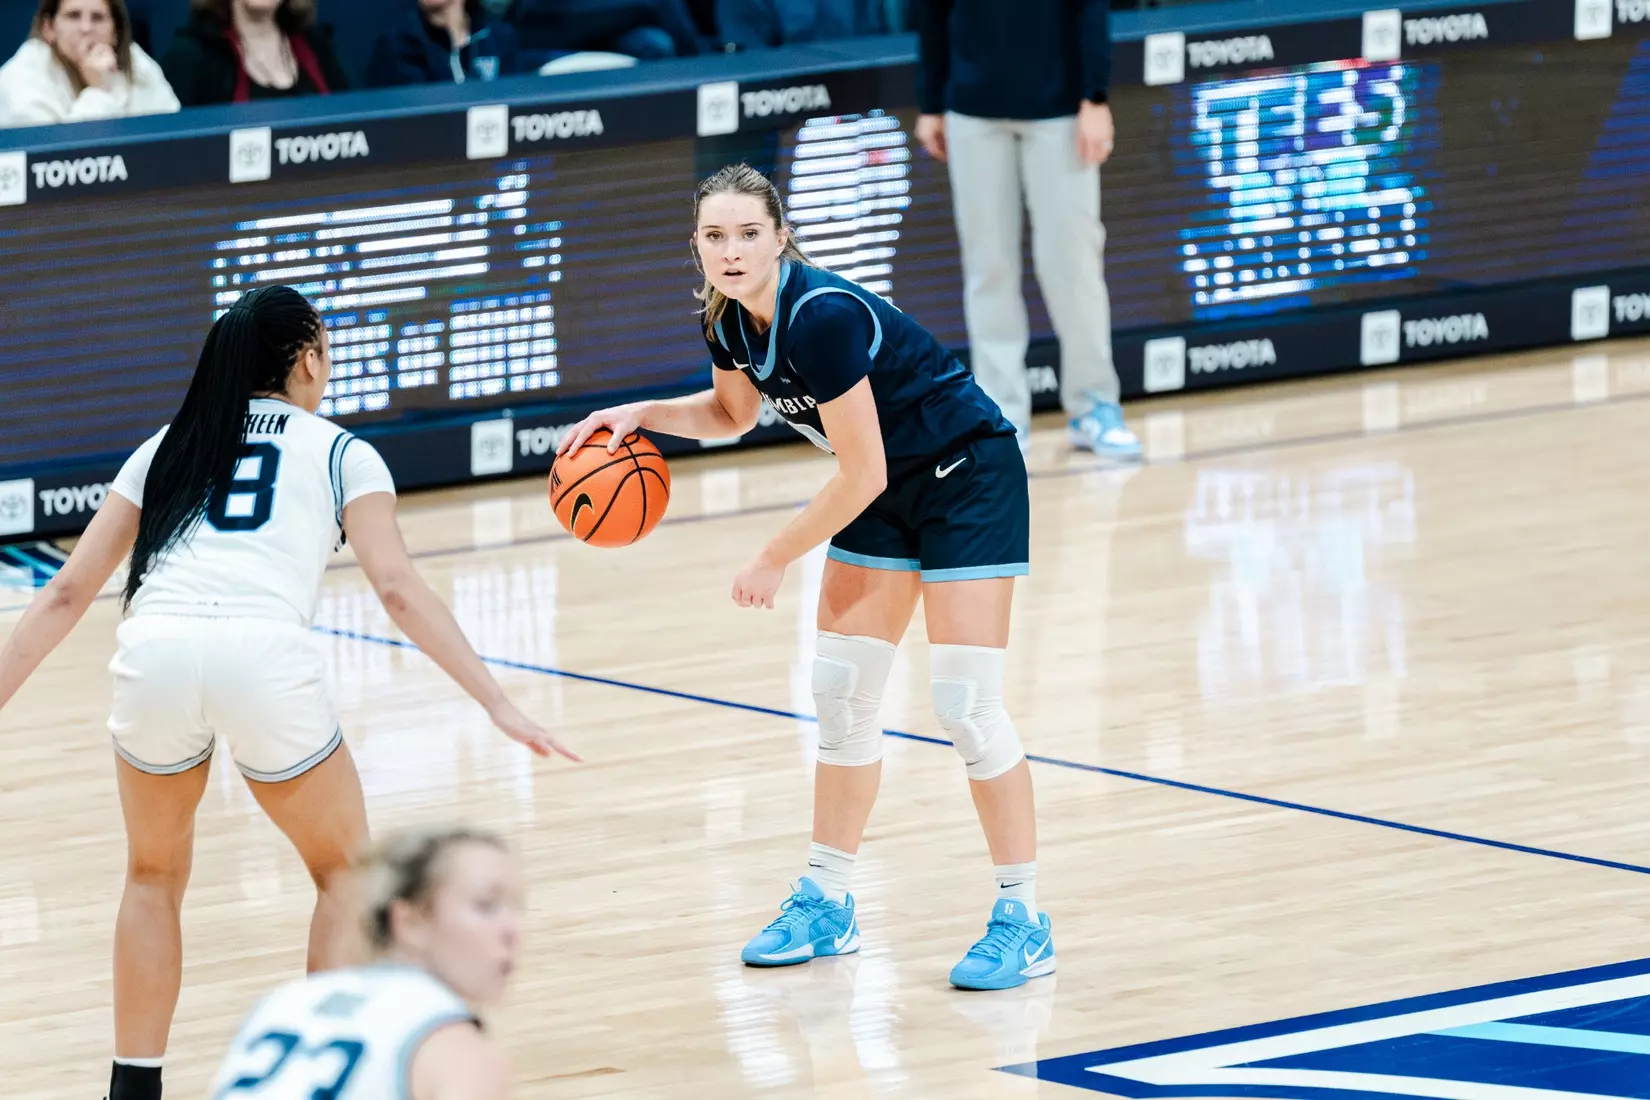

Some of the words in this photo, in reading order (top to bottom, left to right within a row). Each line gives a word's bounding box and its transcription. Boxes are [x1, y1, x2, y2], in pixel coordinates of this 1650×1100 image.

[1404, 13, 1488, 44] TOYOTA
[1187, 35, 1274, 66] TOYOTA
[741, 84, 830, 117] TOYOTA
[511, 109, 603, 141] TOYOTA
[275, 131, 369, 164] TOYOTA
[31, 155, 128, 188] TOYOTA
[1404, 312, 1488, 346] TOYOTA
[1188, 339, 1276, 373] TOYOTA
[763, 391, 816, 414] MBIA
[248, 413, 291, 434] REEN
[516, 423, 575, 457] TOY
[39, 482, 112, 516] TOYO
[206, 440, 282, 533] 8
